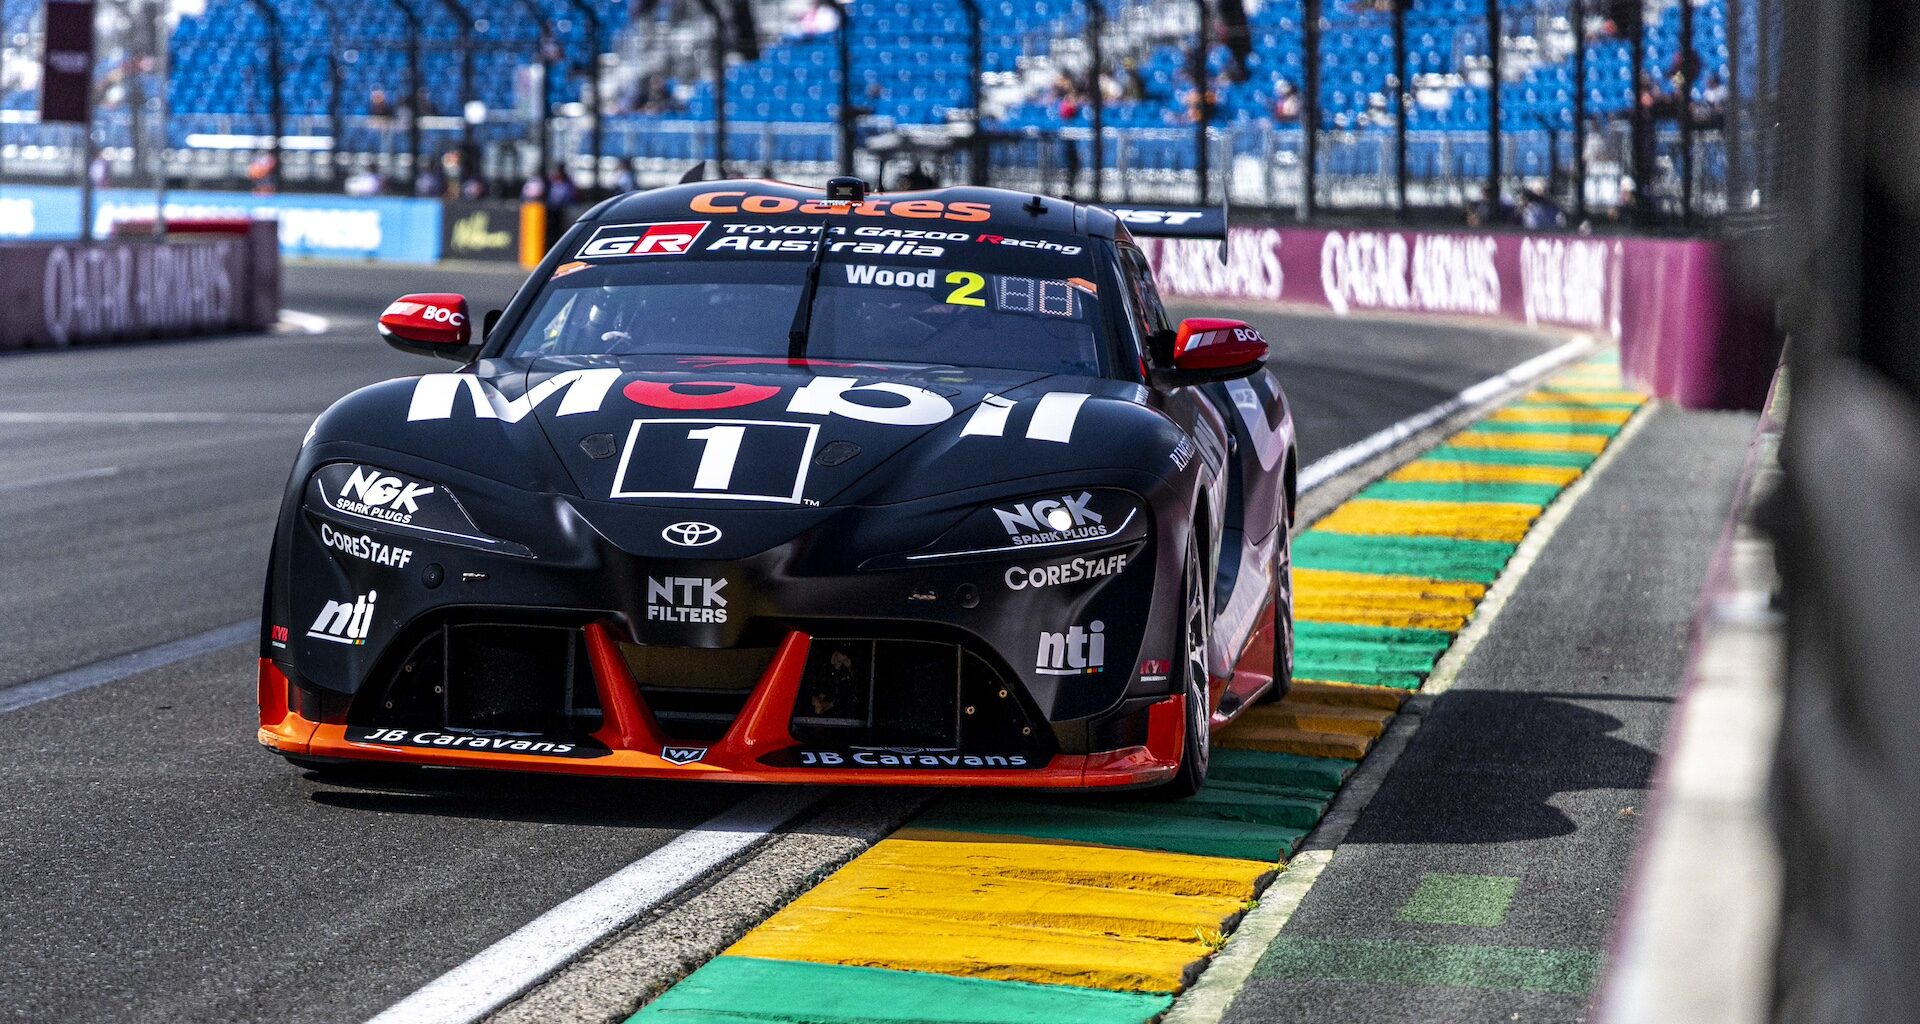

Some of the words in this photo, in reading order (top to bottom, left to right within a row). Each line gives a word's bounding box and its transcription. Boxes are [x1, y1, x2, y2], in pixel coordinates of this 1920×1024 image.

[690, 191, 991, 222] Coates
[584, 234, 694, 256] GR
[706, 235, 945, 258] Australia
[722, 224, 847, 235] TOYOTA
[854, 226, 970, 242] GAZOO
[975, 233, 1082, 255] Racing
[845, 265, 936, 289] Wood
[945, 271, 986, 307] 2
[422, 305, 465, 327] BOC
[407, 367, 1092, 444] Mobil
[687, 425, 747, 490] 1
[340, 465, 435, 514] NGK
[336, 497, 369, 516] SPARK
[370, 506, 412, 525] PLUGS
[992, 491, 1103, 535] NGK
[1012, 531, 1059, 546] SPARK
[1062, 524, 1108, 540] PLUGS
[648, 575, 728, 607] NTK
[310, 589, 378, 638] nti
[647, 605, 728, 623] FILTERS
[1037, 619, 1105, 669] nti
[364, 728, 404, 742] JB
[412, 731, 576, 754] Caravans
[802, 751, 844, 766] JB
[852, 752, 1028, 767] Caravans
